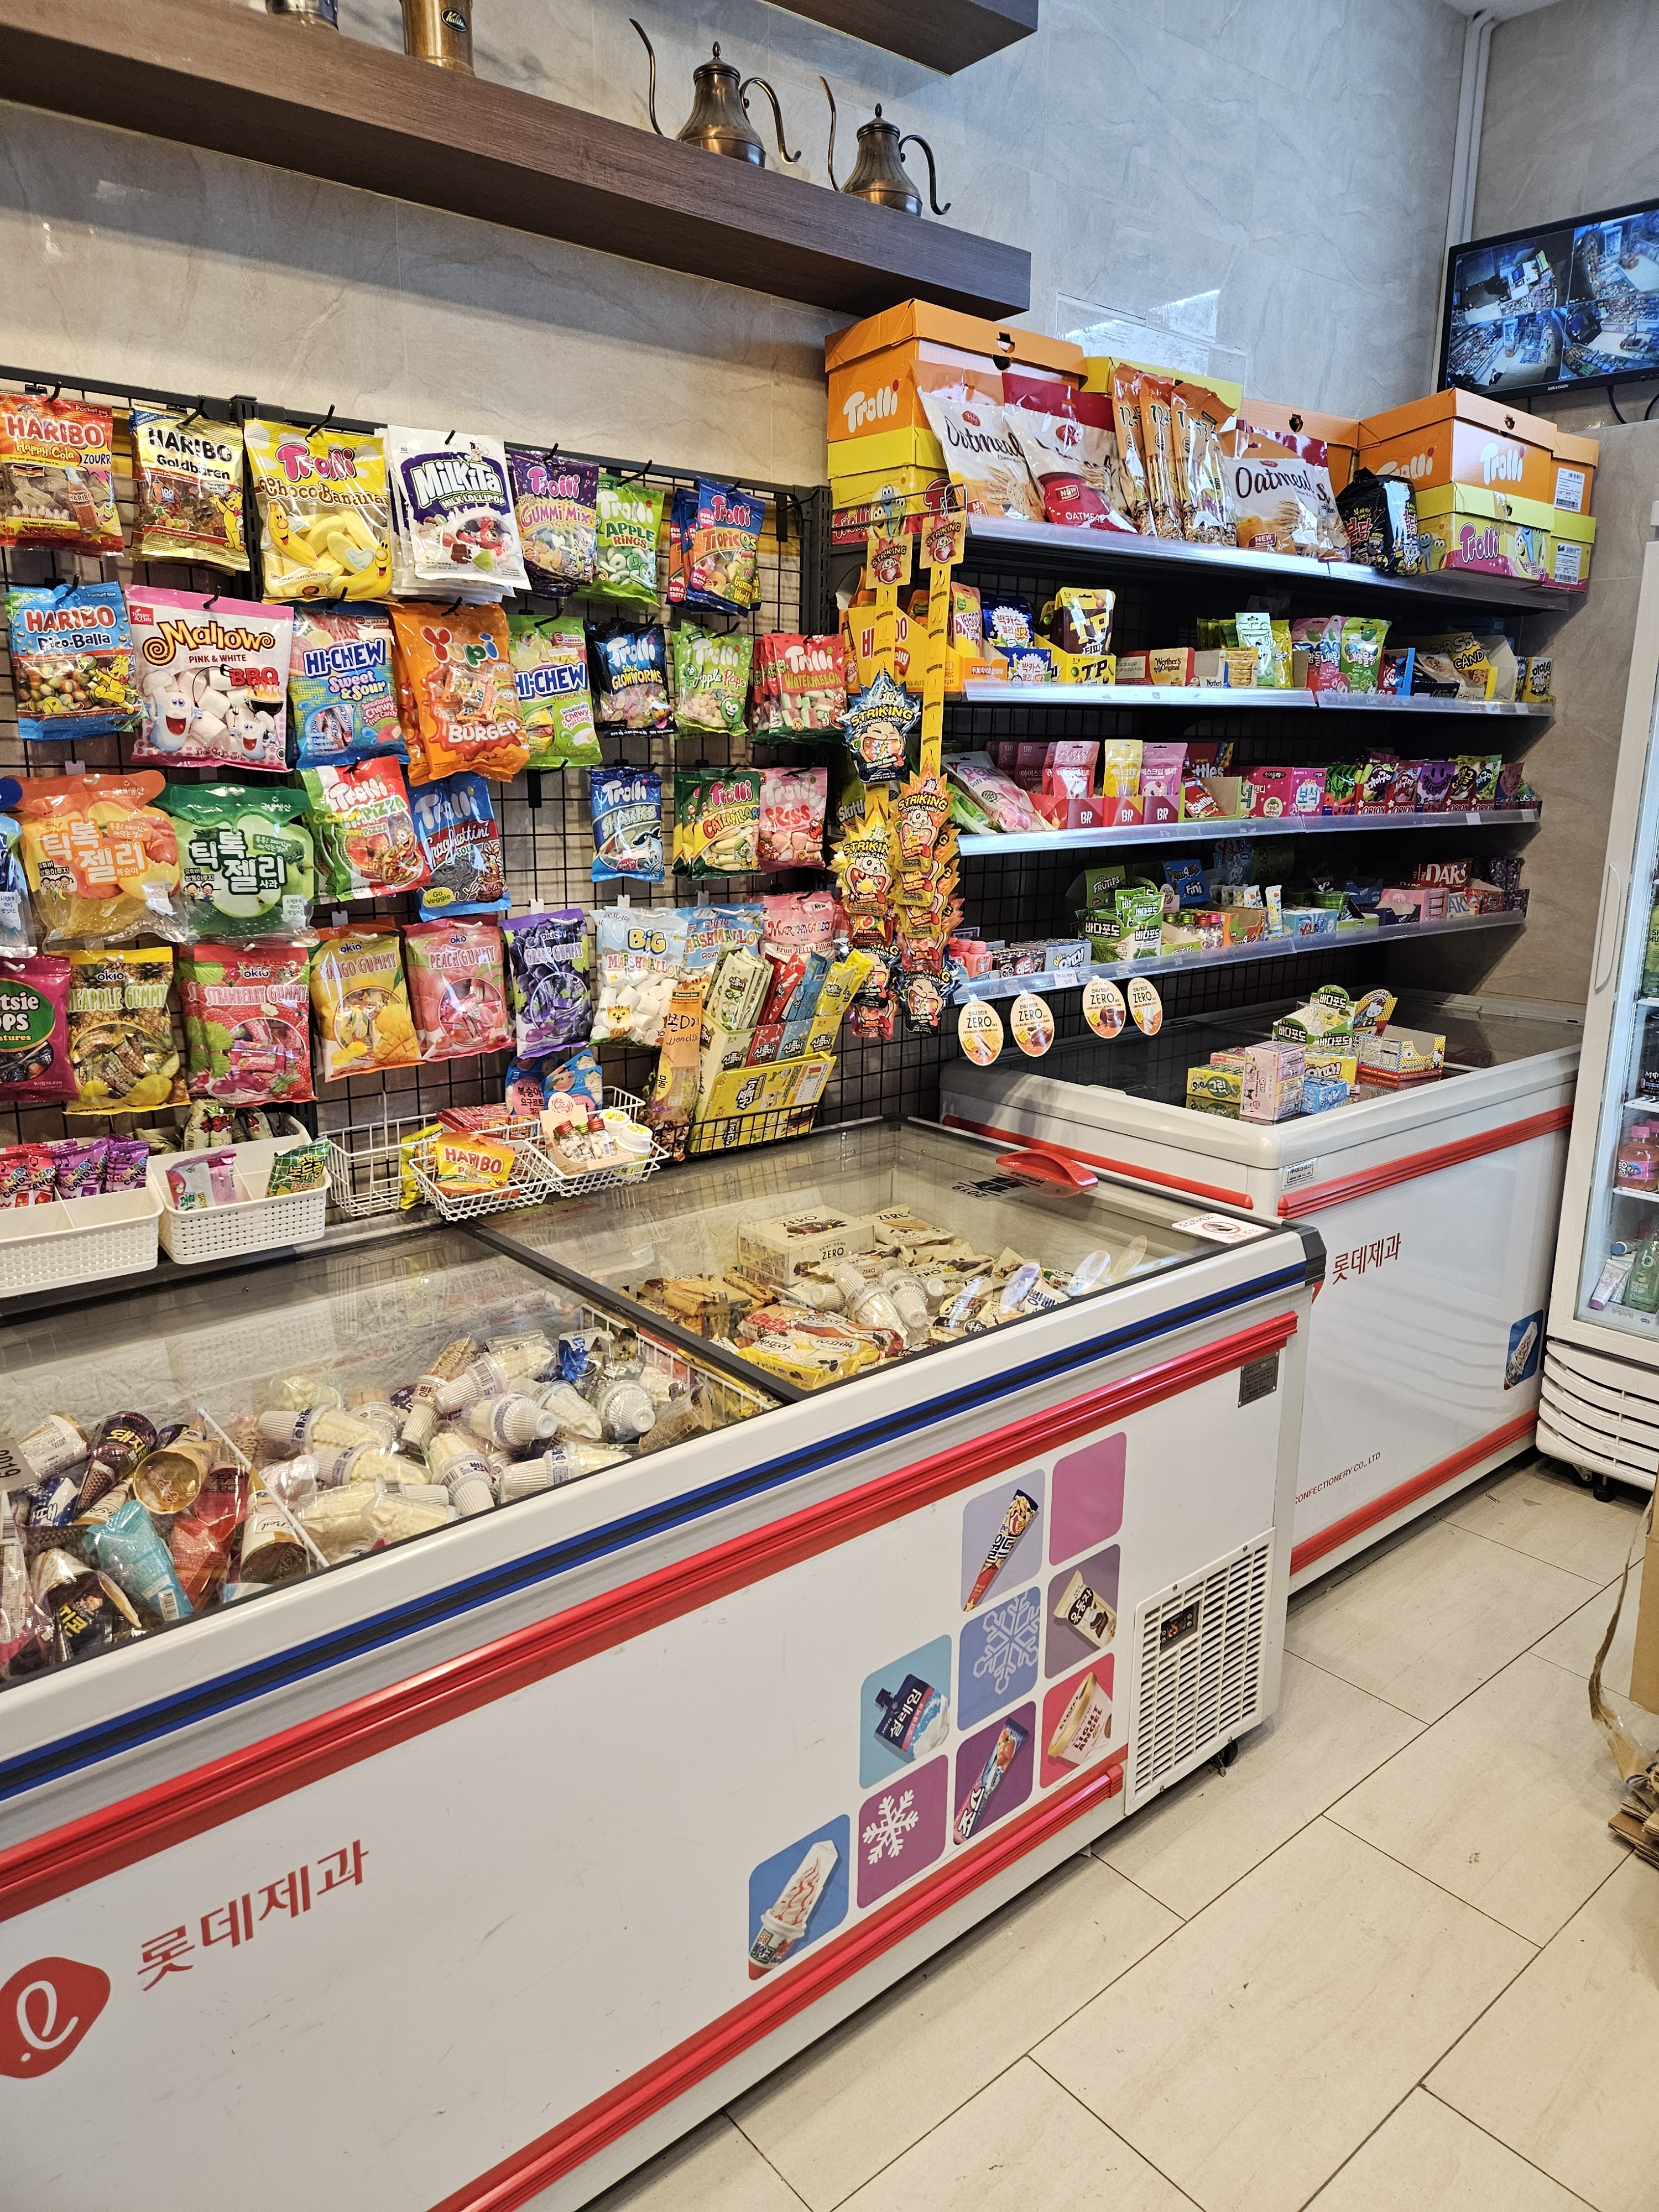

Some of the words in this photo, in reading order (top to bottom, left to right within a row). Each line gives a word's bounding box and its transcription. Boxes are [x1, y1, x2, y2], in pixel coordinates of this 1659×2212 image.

[75, 405, 97, 414] Pocket
[843, 380, 899, 433] Trolli
[6, 415, 104, 447] HARIBO
[945, 416, 1025, 457] Oatmeal
[15, 441, 49, 457] Happy
[51, 447, 74, 460] Cola
[148, 427, 232, 462] HARIBO
[84, 453, 111, 465] ZOURR
[276, 442, 356, 482] Trolli
[1481, 442, 1525, 485] Trolli
[527, 466, 580, 498] Trolli
[1235, 467, 1315, 498] Oatmeal
[69, 493, 92, 502] HARIBO
[161, 488, 173, 496] 100
[441, 496, 463, 510] MILK
[463, 494, 505, 506] LOLLIPOP
[598, 491, 653, 524] Trolli
[711, 495, 751, 527] Trolli
[700, 518, 714, 528] TASTY
[606, 523, 655, 542] APPLE
[927, 523, 961, 547] STRIKING
[1459, 522, 1499, 563] Trolli
[872, 546, 906, 568] STRIKING
[692, 578, 706, 588] TASTY
[670, 592, 685, 601] TASTY
[26, 607, 114, 633] HARIBO
[997, 614, 1023, 625] 박카스
[1001, 625, 1014, 634] 젤리
[421, 625, 499, 667] Yupi
[607, 635, 655, 667] Trolli
[692, 639, 740, 666] Trolli
[1084, 643, 1100, 655] 티피
[189, 655, 210, 664] PINK
[220, 654, 247, 662] WHITE
[304, 638, 385, 677] HI-CHEW
[785, 645, 834, 672] Trolli
[1155, 657, 1181, 666] Werther's
[622, 664, 639, 673] SOUR
[1022, 662, 1042, 673] 박카스
[1082, 659, 1108, 681] TP
[230, 667, 279, 687] BBQ
[329, 670, 376, 691] Sweet
[515, 662, 588, 699] HI-CHEW
[611, 669, 663, 691] GLOWWORMS
[693, 669, 721, 689] Apple
[723, 670, 747, 688] Pops
[1206, 679, 1222, 687] Werther's
[554, 693, 581, 702] TROPICAL
[884, 693, 894, 701] 10
[364, 703, 394, 719] Chewy
[564, 708, 589, 722] Chewy
[851, 705, 914, 726] STRIKING
[859, 718, 882, 728] POPPING
[883, 715, 904, 724] CANDY
[448, 718, 520, 743] BURGER
[603, 779, 646, 806] Trolli
[709, 779, 752, 807] Trolli
[760, 778, 816, 806] Trolli
[415, 785, 477, 830] Trolli
[898, 794, 948, 811] STRIKING
[922, 805, 938, 813] CANDY
[1364, 806, 1385, 815] ORION
[1392, 805, 1414, 813] ORION
[602, 805, 657, 839] SHARKS
[1081, 811, 1093, 824] BR
[1121, 809, 1134, 822] BR
[1157, 807, 1169, 821] BR
[43, 822, 99, 860] 틱톡
[192, 830, 247, 866] 틱톡
[427, 825, 490, 867] Spaghettini
[457, 844, 474, 857] SOUR
[868, 851, 888, 860] CAND
[38, 860, 54, 869] 유튜버
[80, 844, 146, 884] 젤리
[116, 867, 139, 877] 복숭아
[226, 855, 285, 892] 젤리
[260, 879, 278, 889] 사과
[426, 894, 451, 905] Veggie
[1085, 921, 1121, 937] 바다포도
[1135, 927, 1160, 940] 바다포도
[341, 942, 362, 953] okio
[450, 934, 467, 944] okio
[776, 945, 793, 953] Fruit
[794, 945, 814, 954] JELLY
[815, 940, 833, 953] Filling
[429, 950, 459, 969] PEACH
[459, 946, 495, 966] GUMMY
[552, 942, 582, 961] GUMMY
[358, 952, 398, 973] GUMMY
[607, 954, 681, 979] MARSHMALLOW
[1016, 958, 1034, 972] 레드
[97, 969, 124, 982] okio
[244, 968, 269, 978] okio
[126, 985, 168, 1009] GUMMY
[205, 987, 265, 1005] STRAWBERRY
[266, 984, 307, 1003] GUMMY
[1091, 993, 1115, 1005] ZERO
[1133, 992, 1152, 1004] ZERO
[1319, 993, 1347, 1010] 바다포도
[967, 1016, 993, 1030] ZERO
[1019, 1009, 1043, 1022] ZERO
[1278, 1027, 1307, 1042] 바다포도
[1318, 1036, 1350, 1047] 바다포도
[518, 1087, 542, 1098] 복숭아
[445, 1146, 503, 1175] HARIBO
[288, 1159, 326, 1183] 논두렁
[952, 1185, 988, 1199] 2019
[780, 1214, 817, 1227] ZERO
[822, 1247, 844, 1260] ZERO
[1332, 1233, 1402, 1285] 롯데제과
[1368, 1452, 1381, 1465] LTD
[1071, 1588, 1094, 1625] 옥동자
[889, 1688, 922, 1739] 설레임
[1074, 1704, 1103, 1749] LIGHT
[1077, 1712, 1105, 1752] ANGEL
[138, 1839, 369, 1992] 롯데제과
